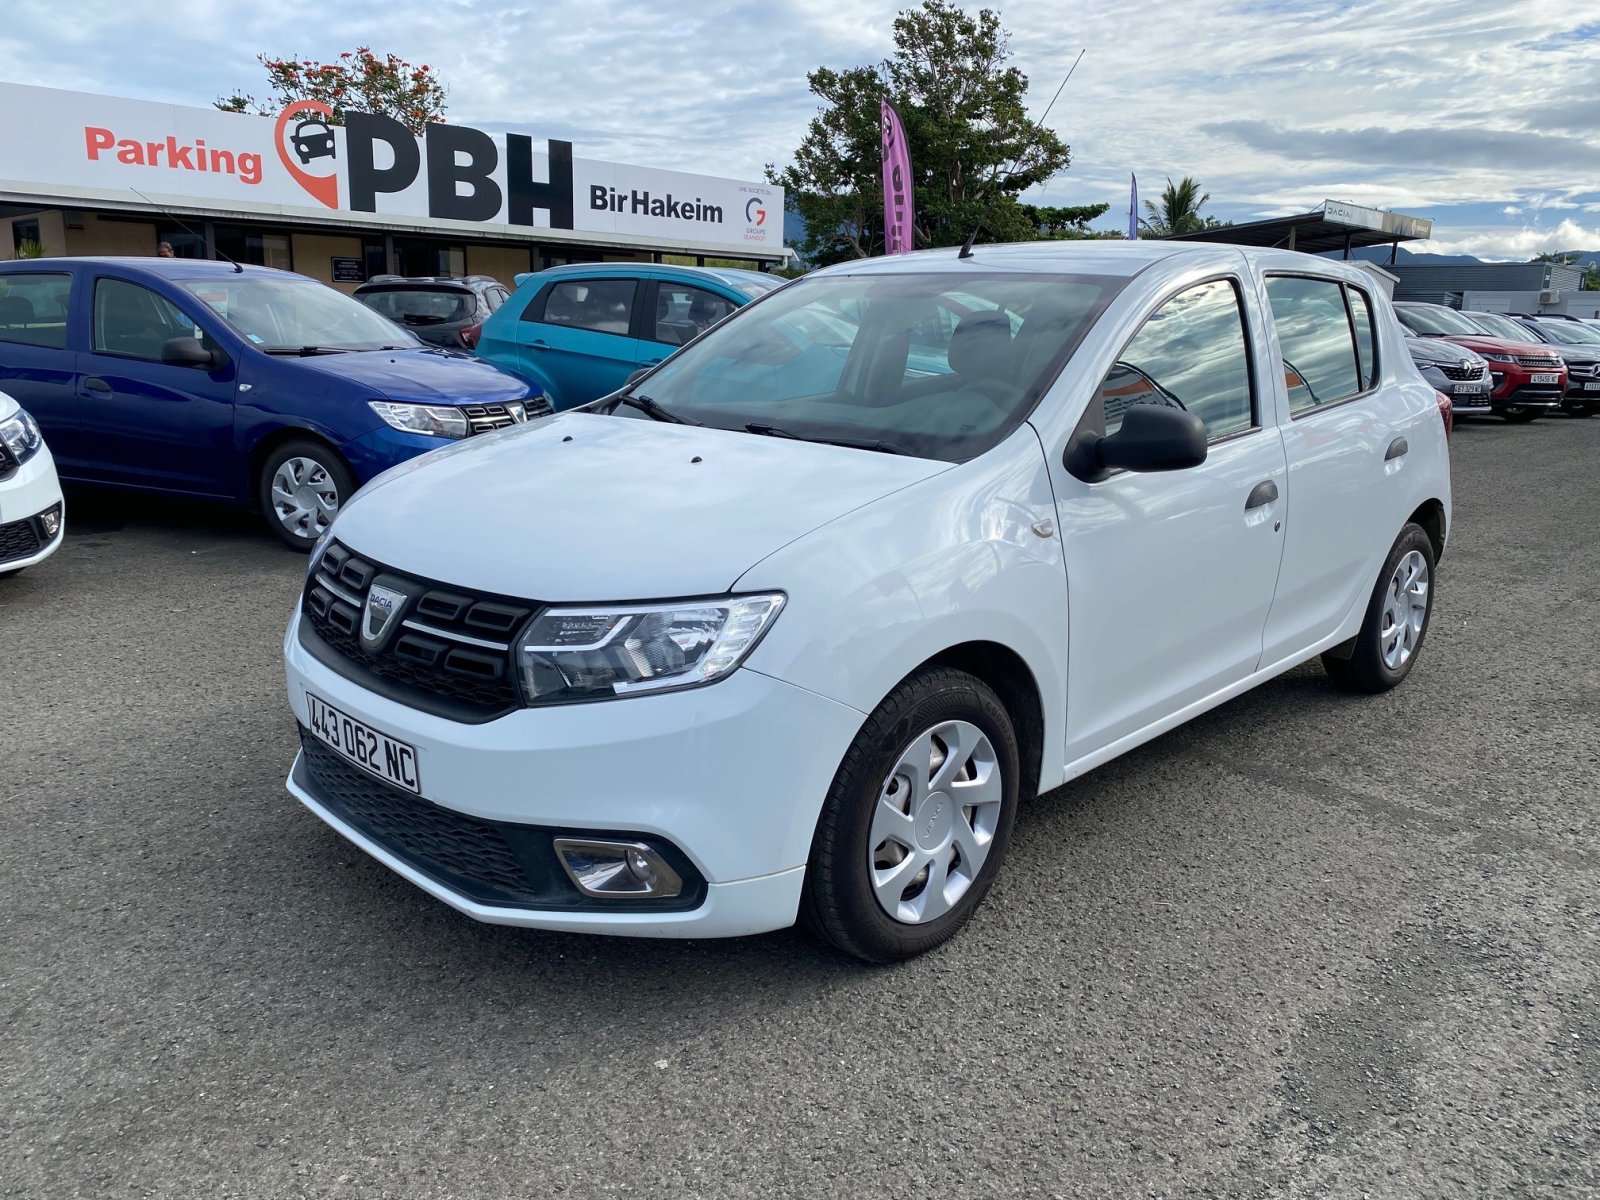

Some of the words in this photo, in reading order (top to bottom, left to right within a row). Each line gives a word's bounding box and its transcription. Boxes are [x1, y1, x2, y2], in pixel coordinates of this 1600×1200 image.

[84, 126, 263, 185] Parking
[345, 110, 574, 230] PBH
[590, 184, 628, 212] Bir
[632, 190, 723, 224] Hakeim
[1327, 208, 1350, 218] DACIA
[370, 594, 392, 609] DACIA
[312, 698, 340, 748] 443
[343, 718, 380, 771] 062
[384, 740, 414, 787] NC
